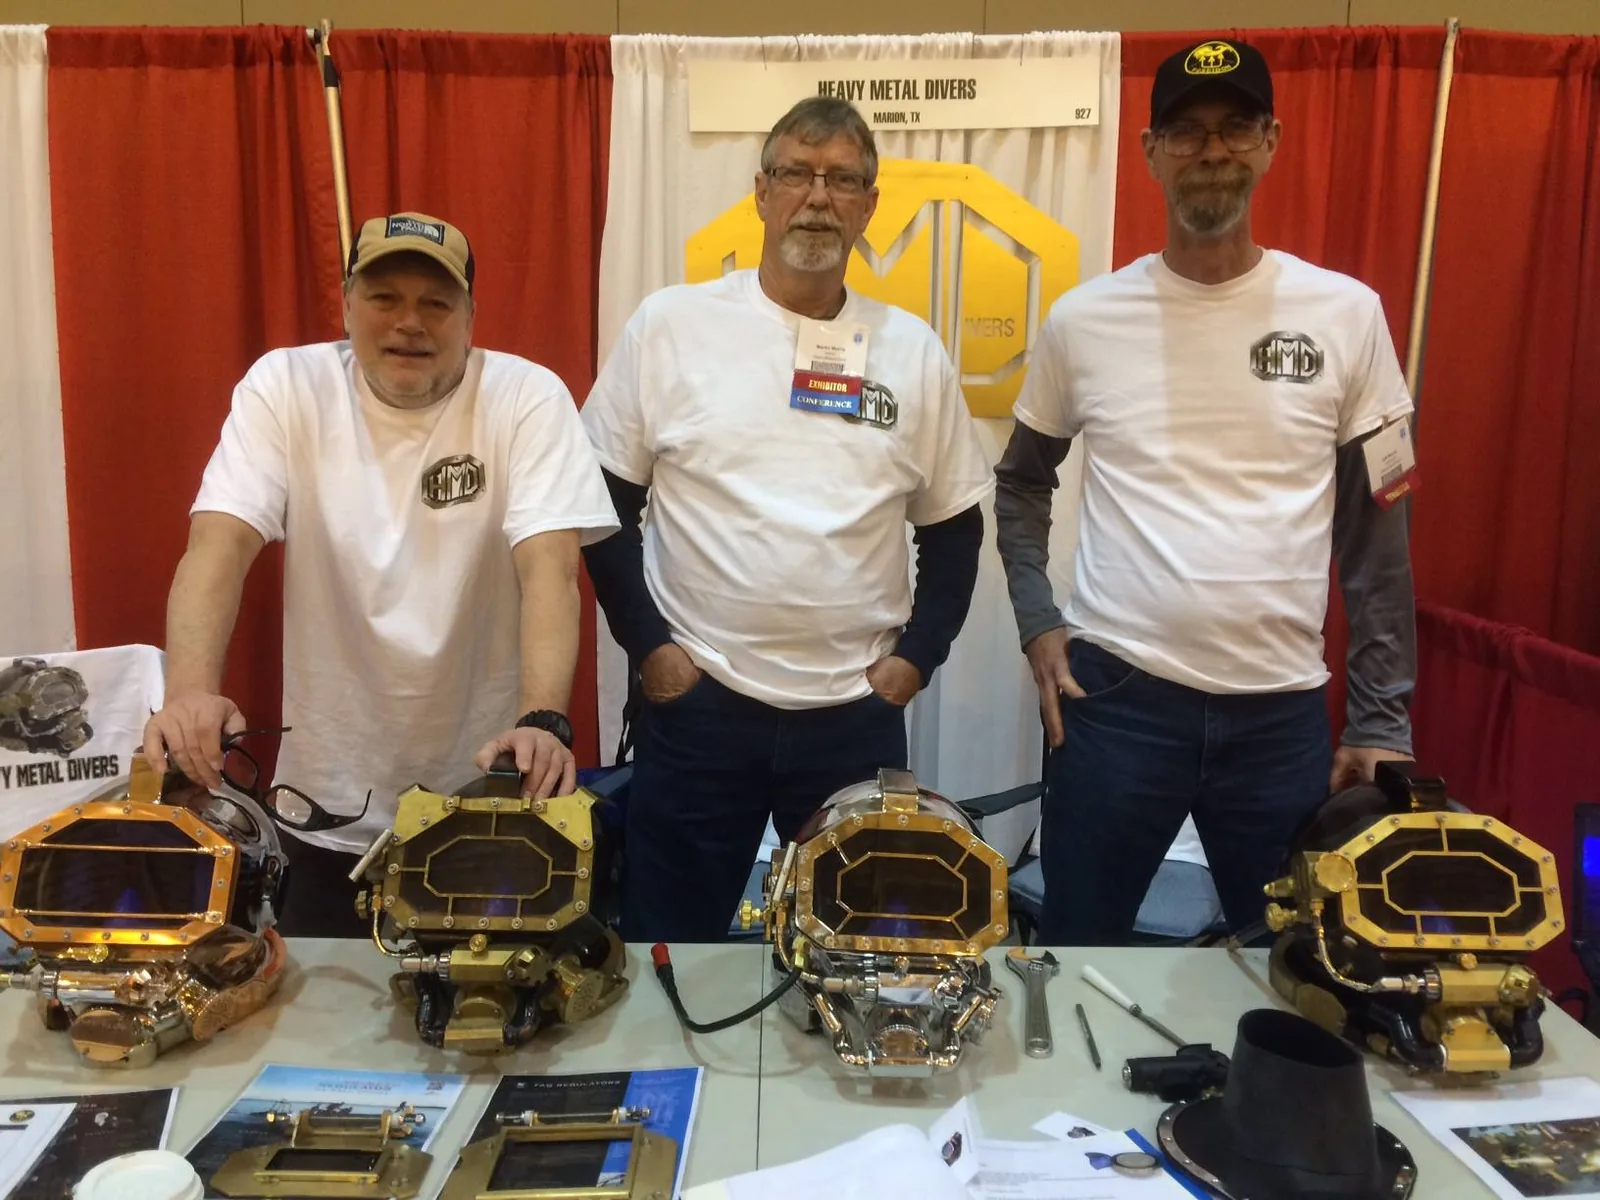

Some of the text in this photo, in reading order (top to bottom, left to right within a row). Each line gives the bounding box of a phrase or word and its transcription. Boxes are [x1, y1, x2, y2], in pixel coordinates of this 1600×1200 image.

[818, 78, 976, 101] HEAVY METAL DIVERS
[873, 112, 921, 125] MARION, TX
[1075, 108, 1091, 120] 927
[1256, 337, 1319, 379] HMD
[809, 379, 847, 393] EXHIBITOR
[797, 395, 852, 409] CONFERENCE
[861, 384, 898, 426] MD
[427, 460, 481, 502] HMD
[16, 761, 64, 788] METAL
[68, 754, 119, 781] DIVERS
